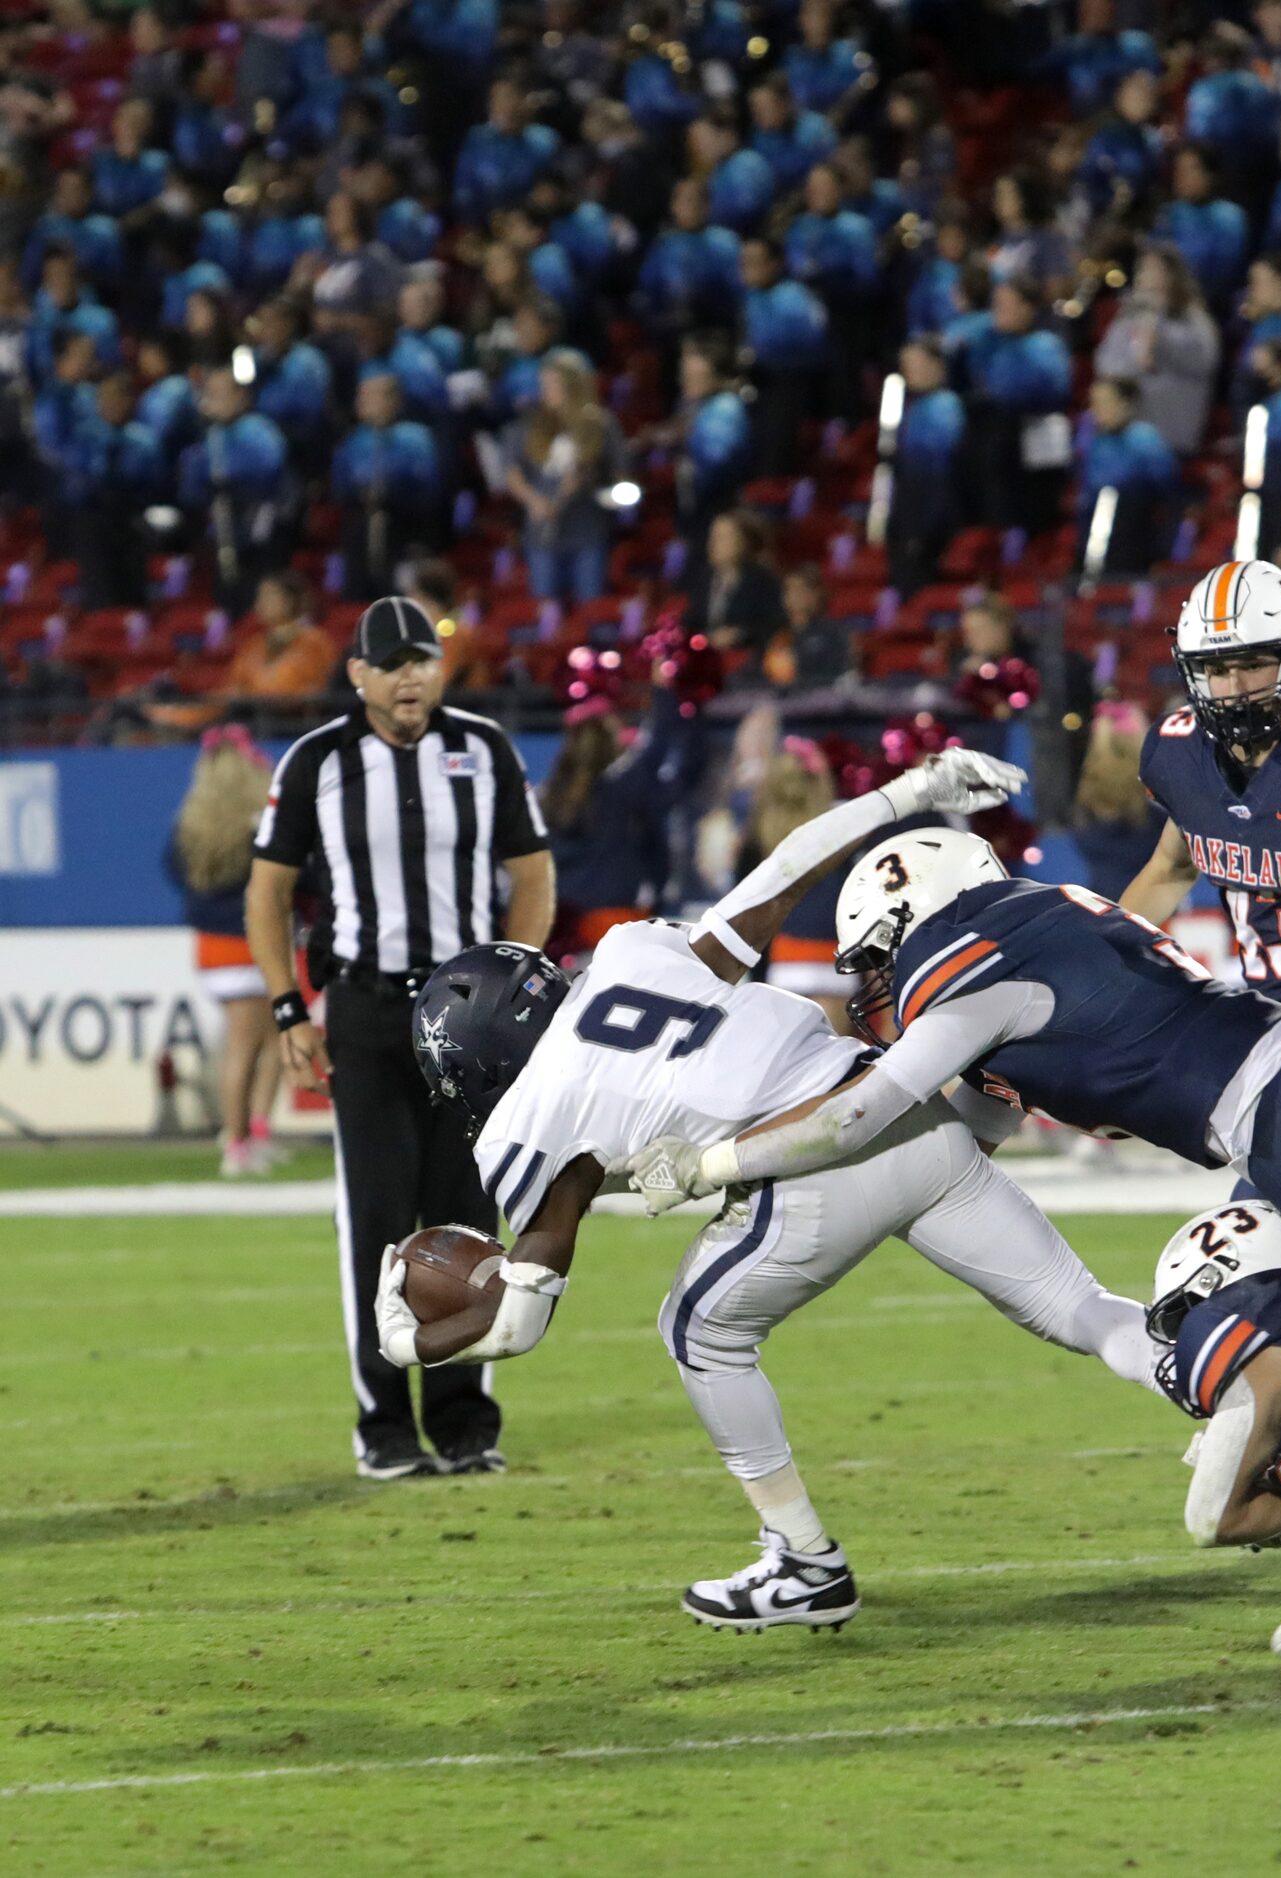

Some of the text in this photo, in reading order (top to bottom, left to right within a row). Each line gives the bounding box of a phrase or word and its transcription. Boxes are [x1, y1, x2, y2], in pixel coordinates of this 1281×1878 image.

[1208, 634, 1232, 645] TEAM
[875, 852, 909, 893] 3
[0, 993, 208, 1065] YOTA
[573, 983, 729, 1062] 9
[1189, 1206, 1262, 1258] 23
